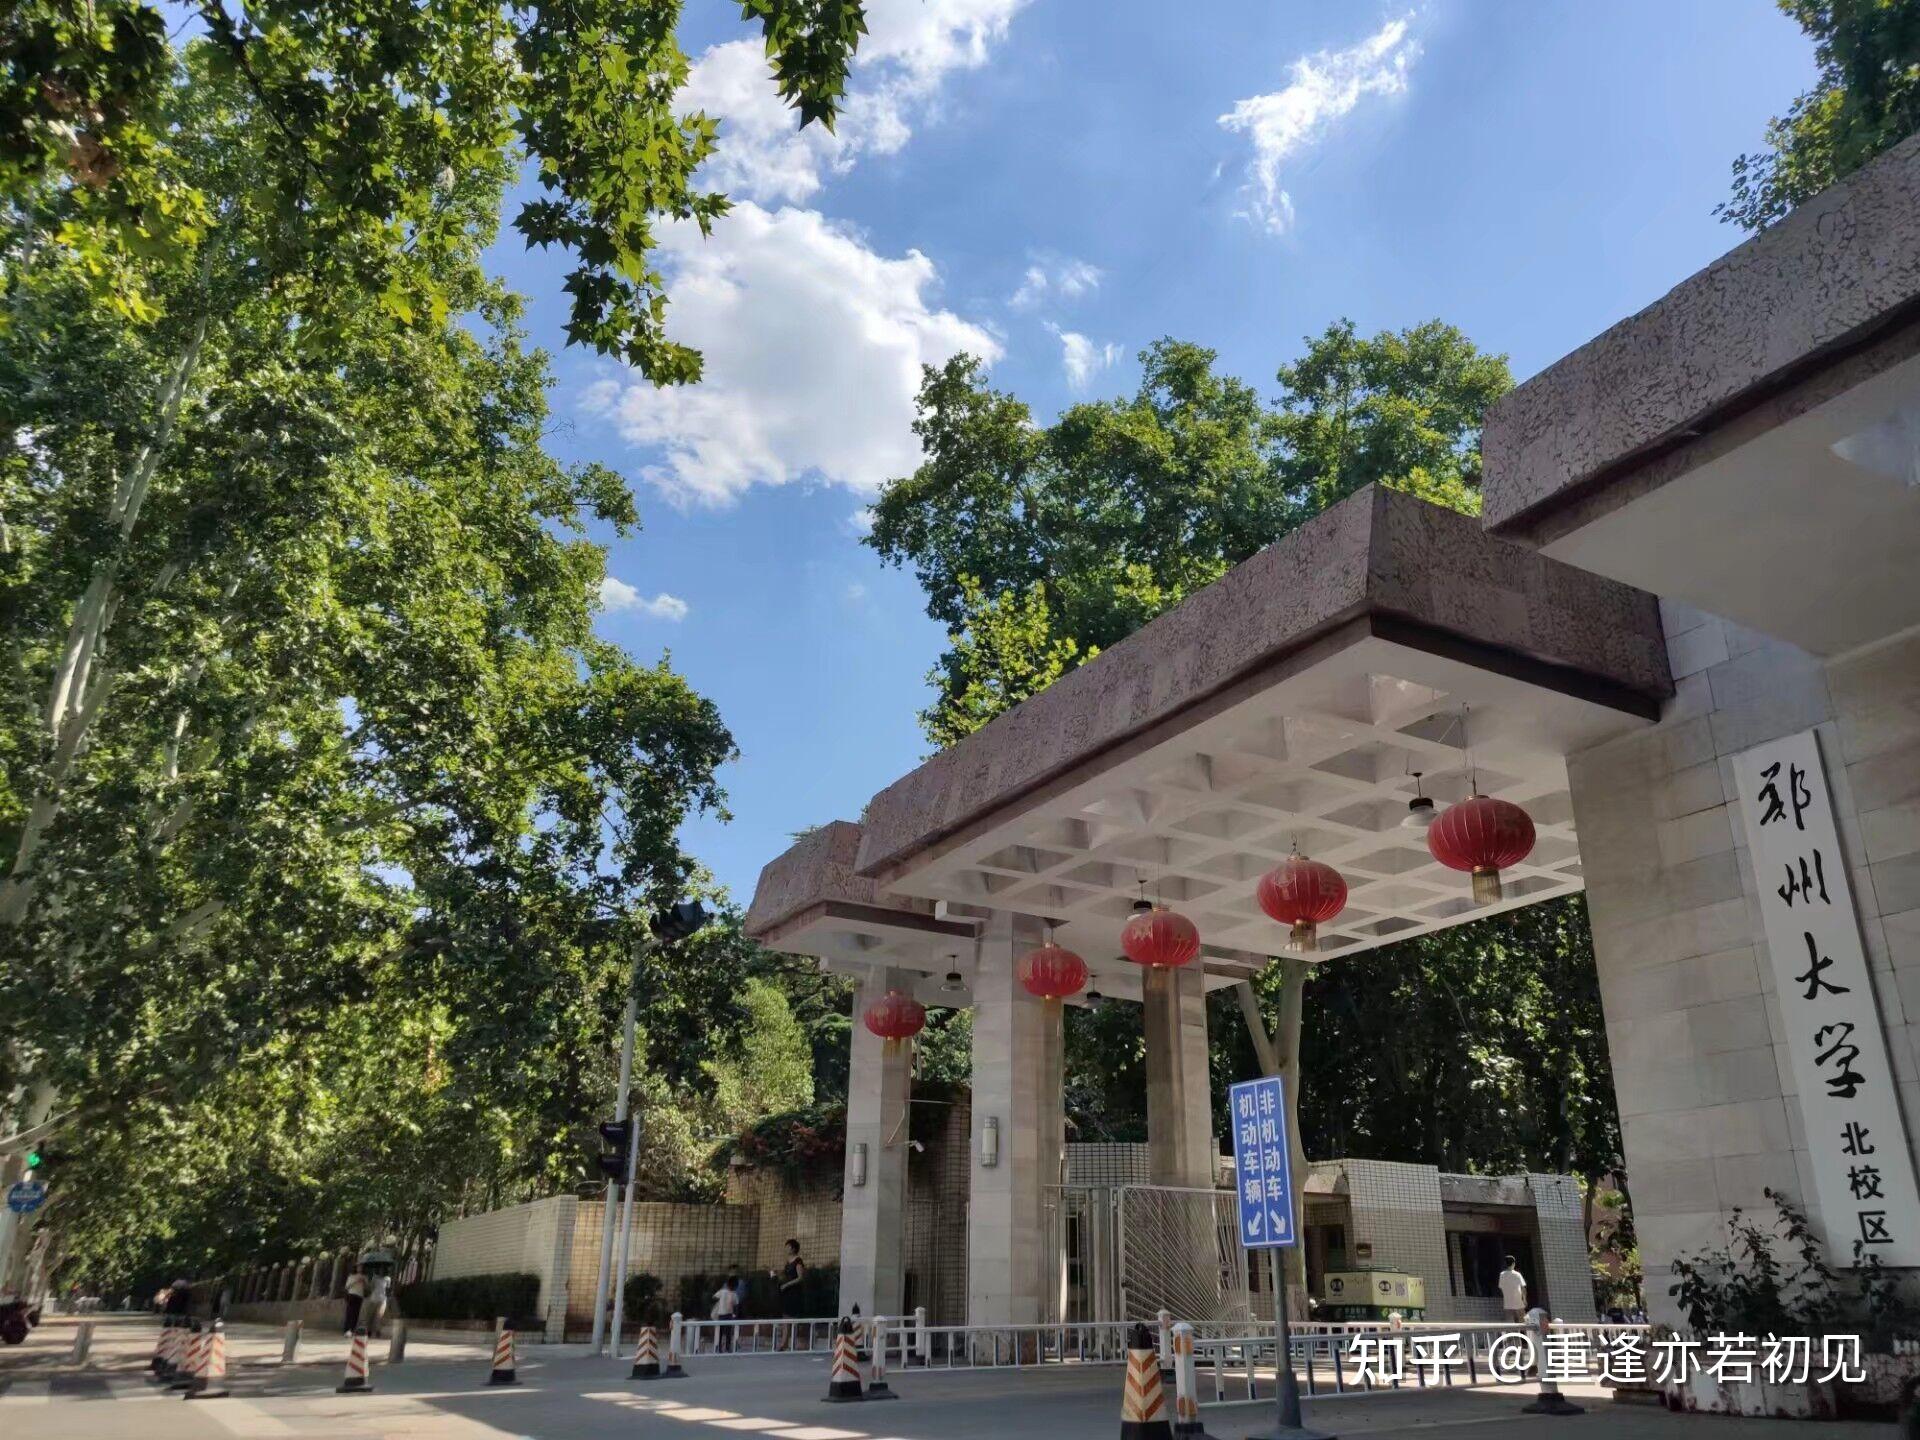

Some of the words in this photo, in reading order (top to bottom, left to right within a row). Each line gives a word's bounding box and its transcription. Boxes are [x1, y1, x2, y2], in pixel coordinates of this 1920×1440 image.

[1758, 761, 1866, 1098] 郑州大学
[1239, 1093, 1262, 1205] 机动车辆
[1259, 1089, 1283, 1202] 非机动车
[1840, 1121, 1893, 1243] 北校区
